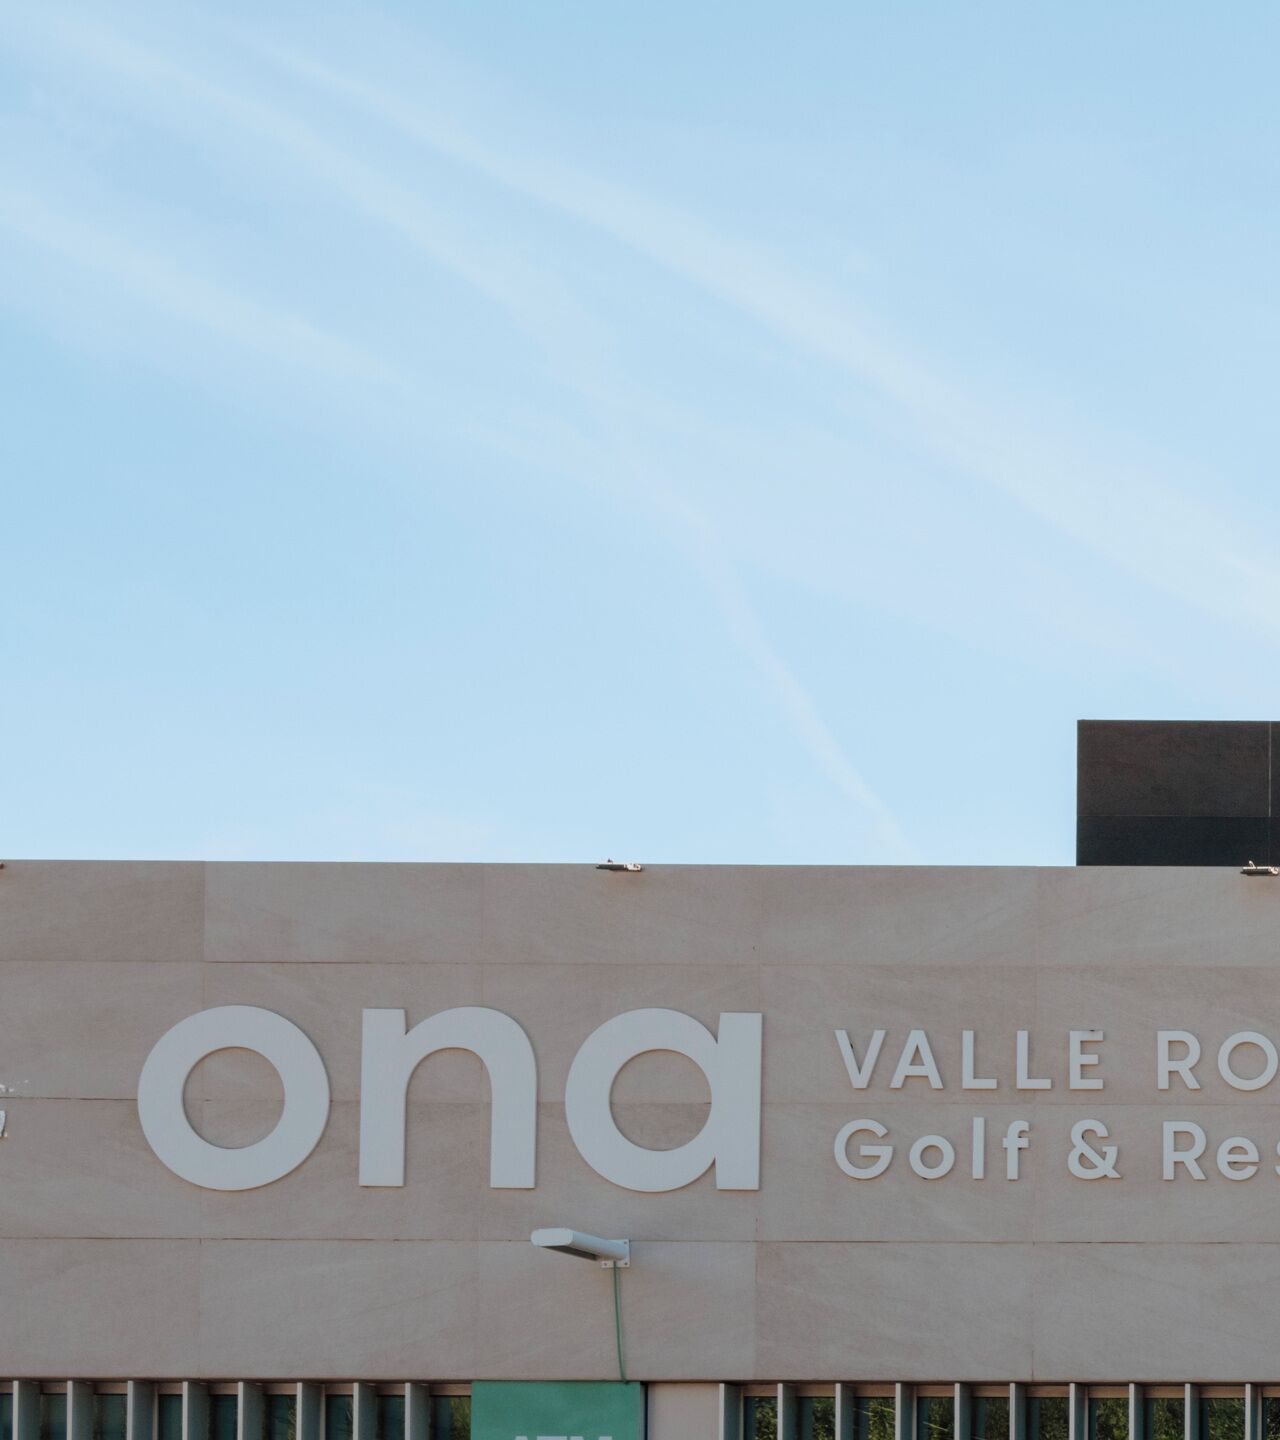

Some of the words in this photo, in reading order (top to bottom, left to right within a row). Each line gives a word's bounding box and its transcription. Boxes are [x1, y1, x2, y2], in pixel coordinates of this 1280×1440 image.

[834, 1029, 1105, 1091] VALLE
[137, 1005, 763, 1192] ona
[833, 1116, 1030, 1181] Golf
[1066, 1118, 1122, 1181] &
